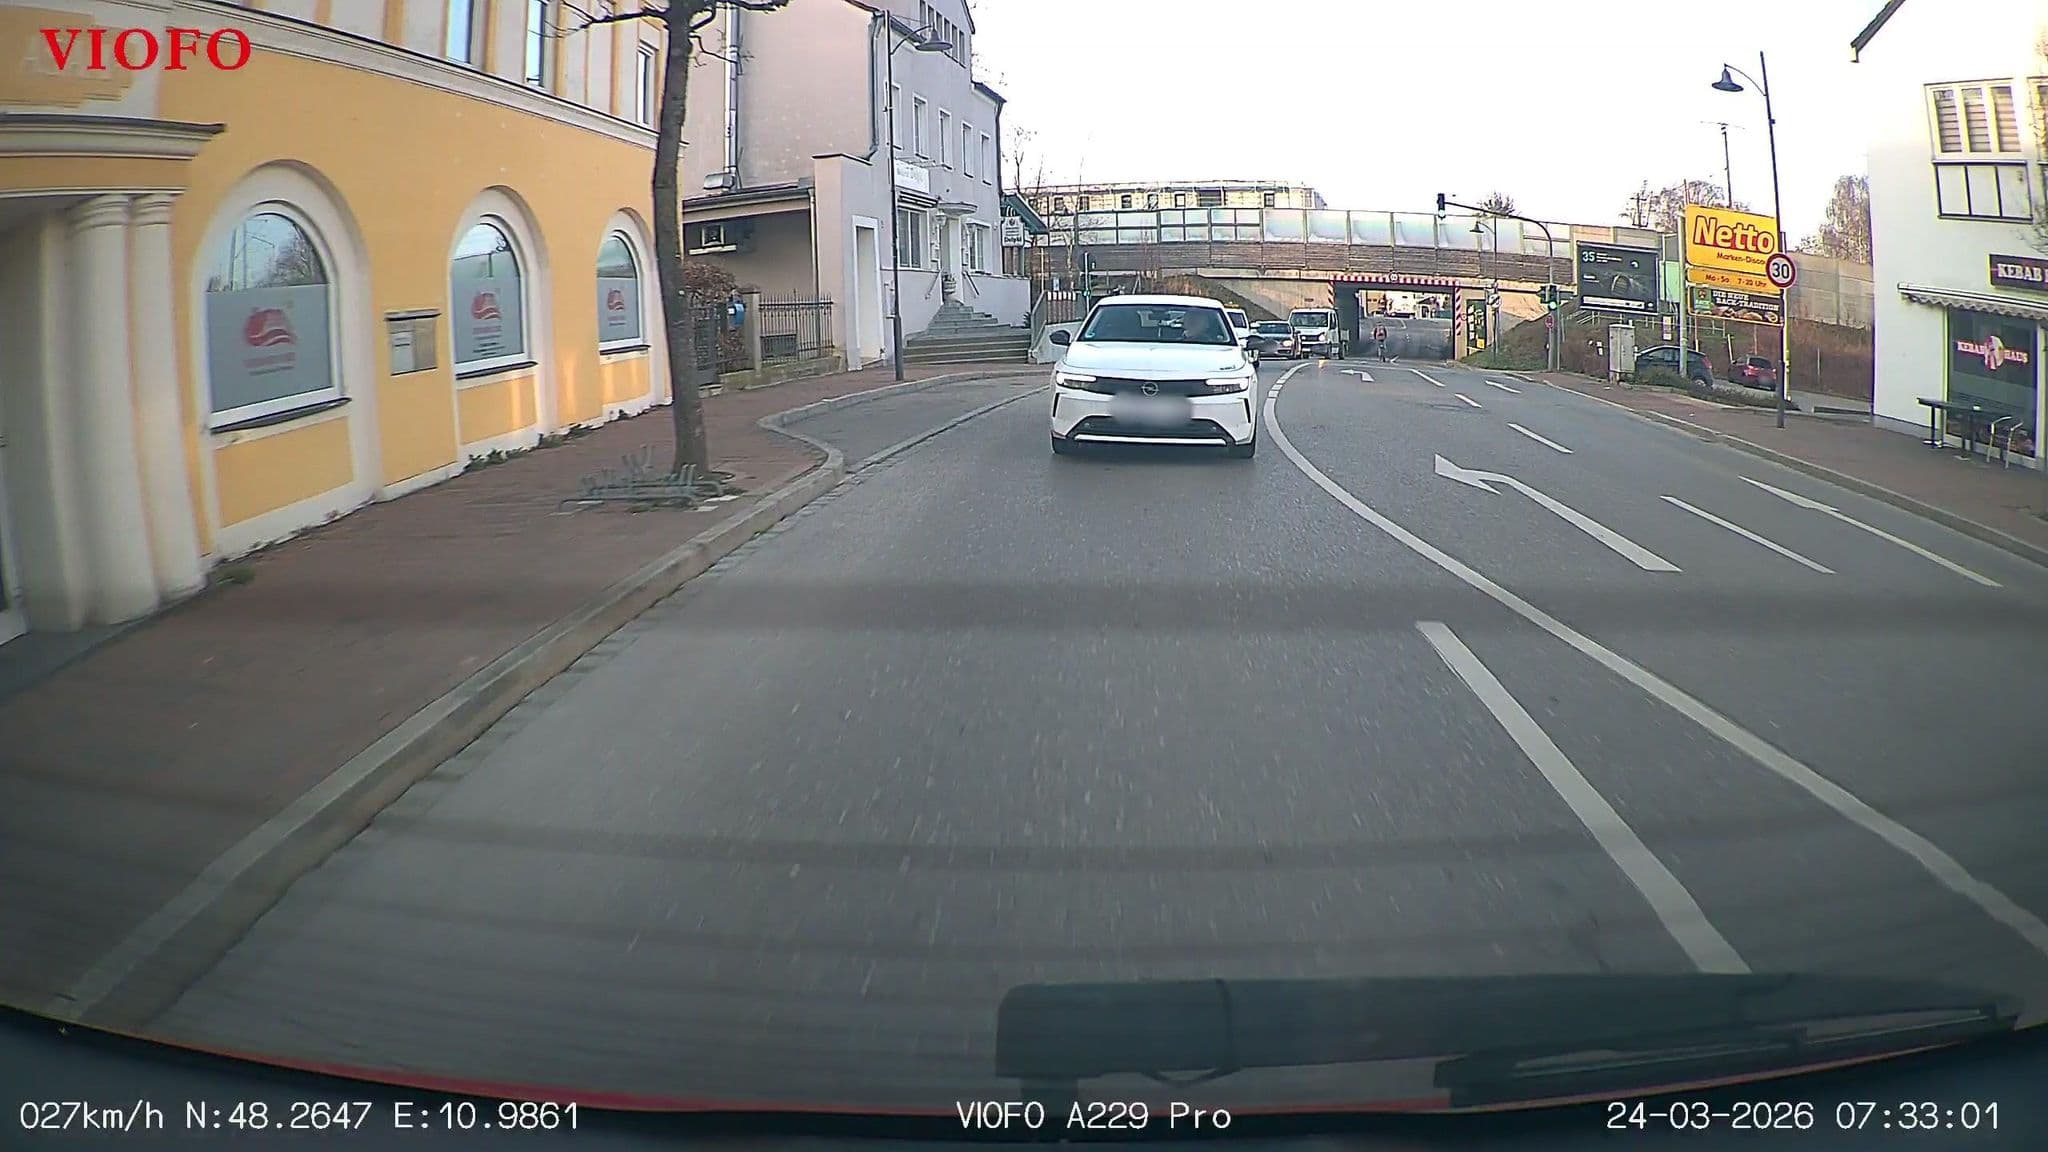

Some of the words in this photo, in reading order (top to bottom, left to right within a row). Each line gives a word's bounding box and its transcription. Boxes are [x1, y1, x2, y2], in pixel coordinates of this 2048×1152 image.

[1693, 215, 1775, 254] Netto
[1717, 252, 1766, 265] Marken-Disco
[1772, 262, 1790, 279] 30
[1997, 263, 2043, 282] KEBAB
